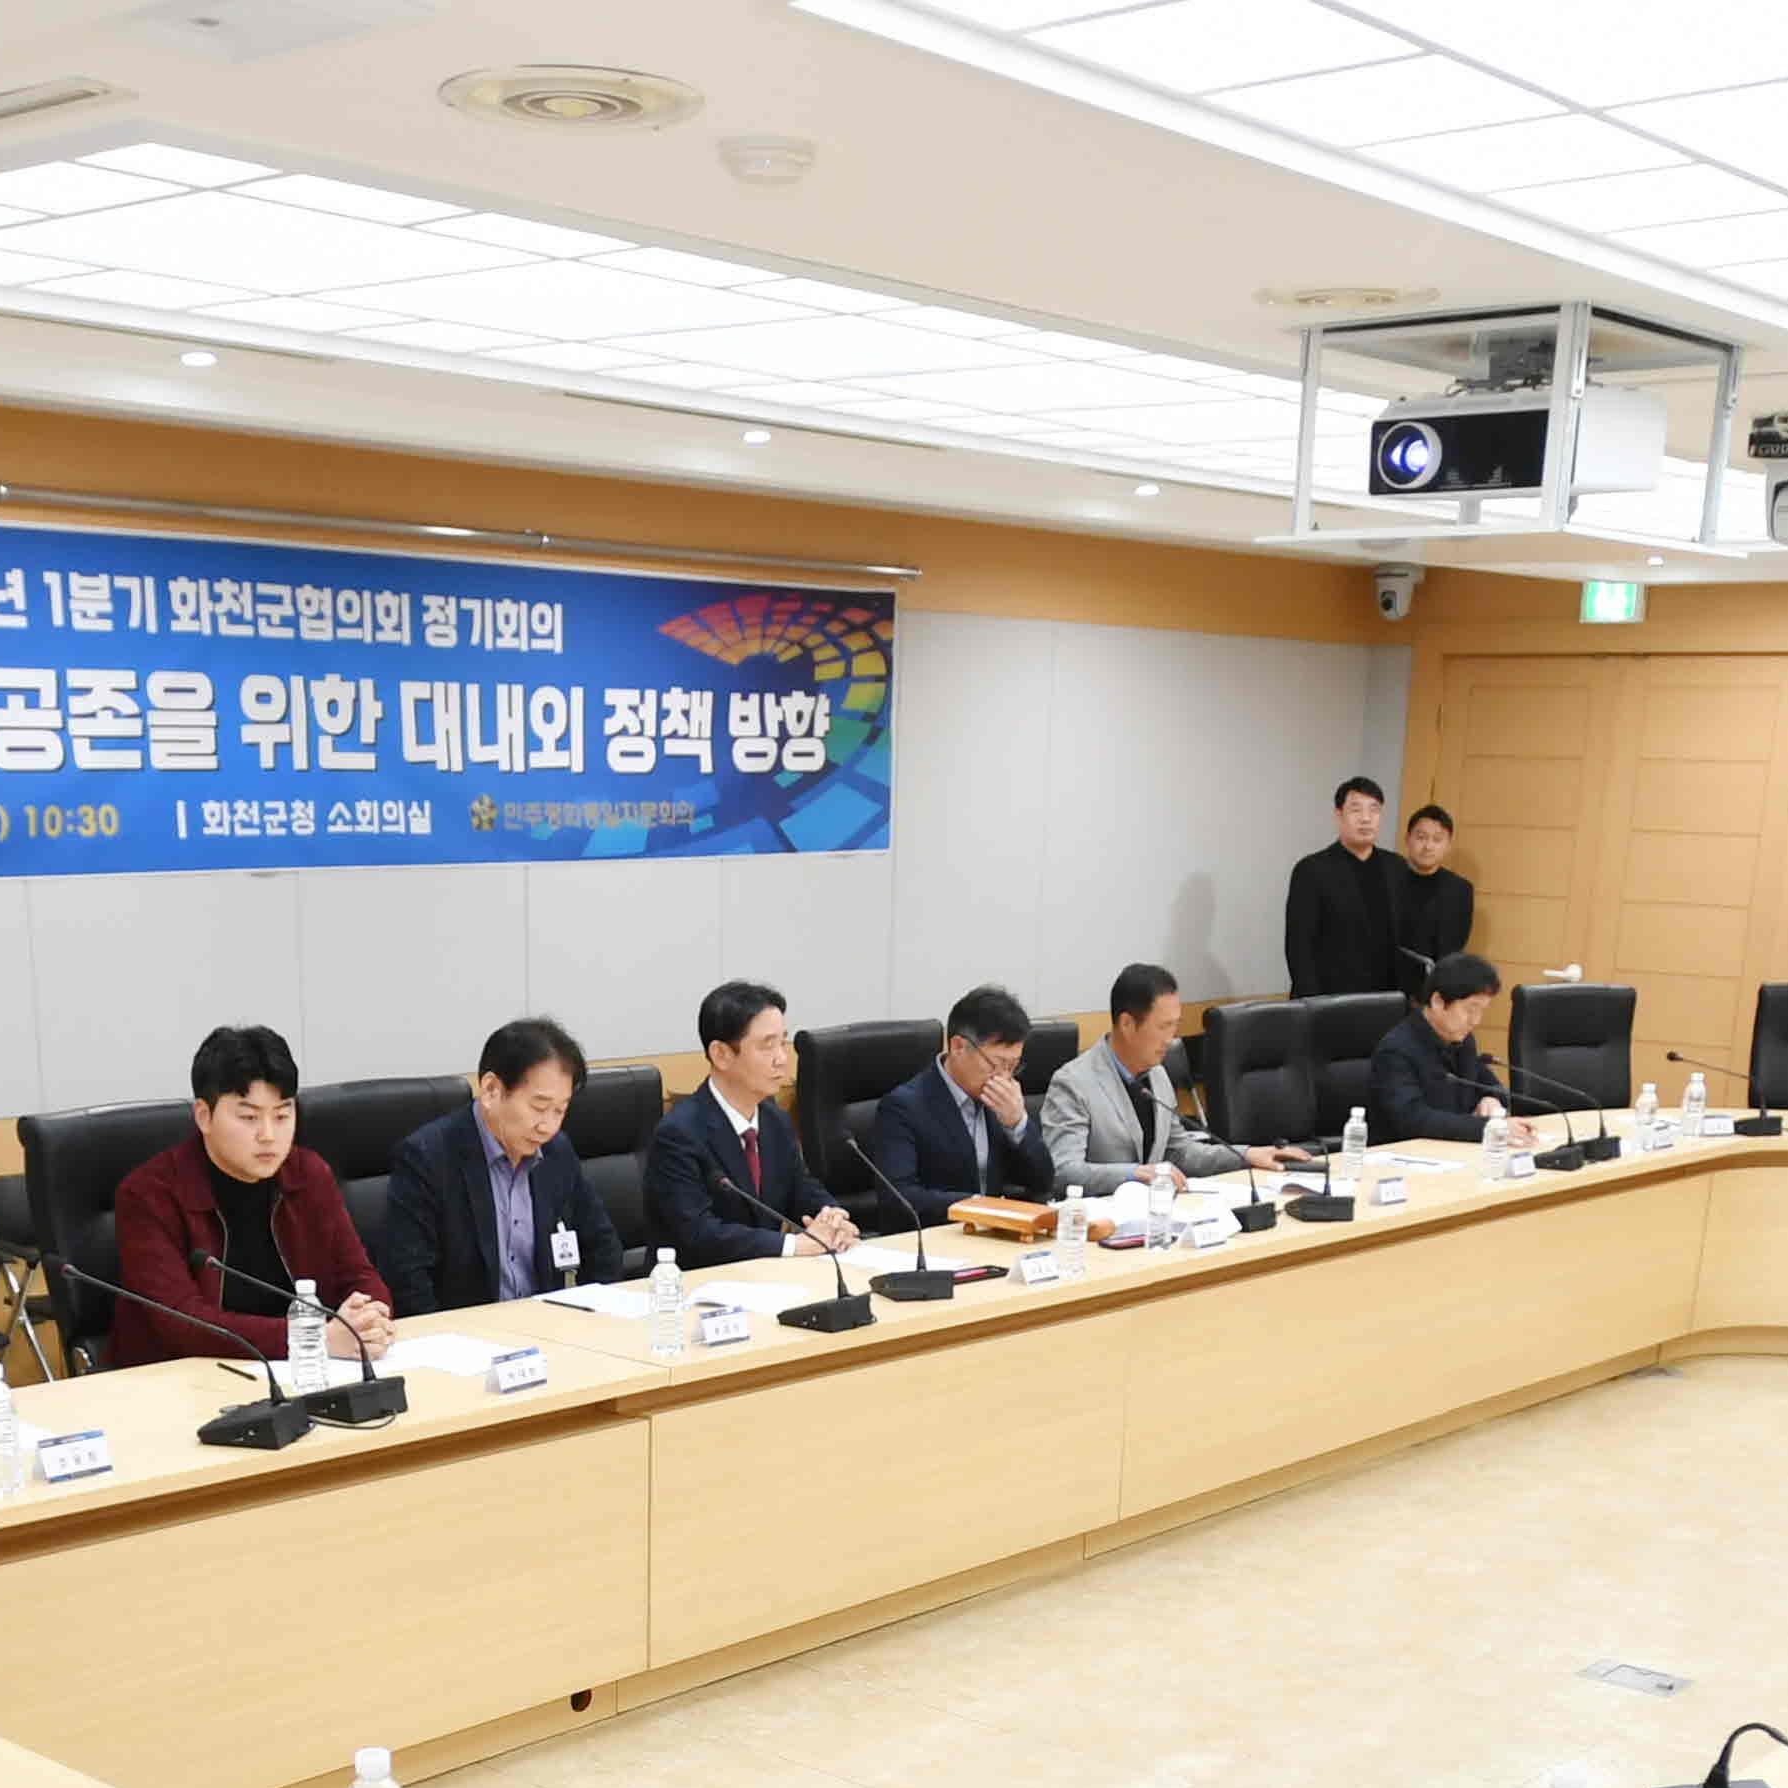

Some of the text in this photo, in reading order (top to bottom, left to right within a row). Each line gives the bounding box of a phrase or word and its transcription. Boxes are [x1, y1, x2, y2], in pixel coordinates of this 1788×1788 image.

[42, 571, 158, 634] 1분기
[168, 576, 412, 646] 화천군협의회
[421, 594, 564, 654] 정기회의
[240, 673, 383, 771] 위한
[399, 681, 584, 773] 대내외
[603, 687, 714, 773] 정책
[727, 689, 832, 773] 방향
[24, 804, 120, 838] 10:30
[201, 799, 432, 837] 화천군청 소회의실
